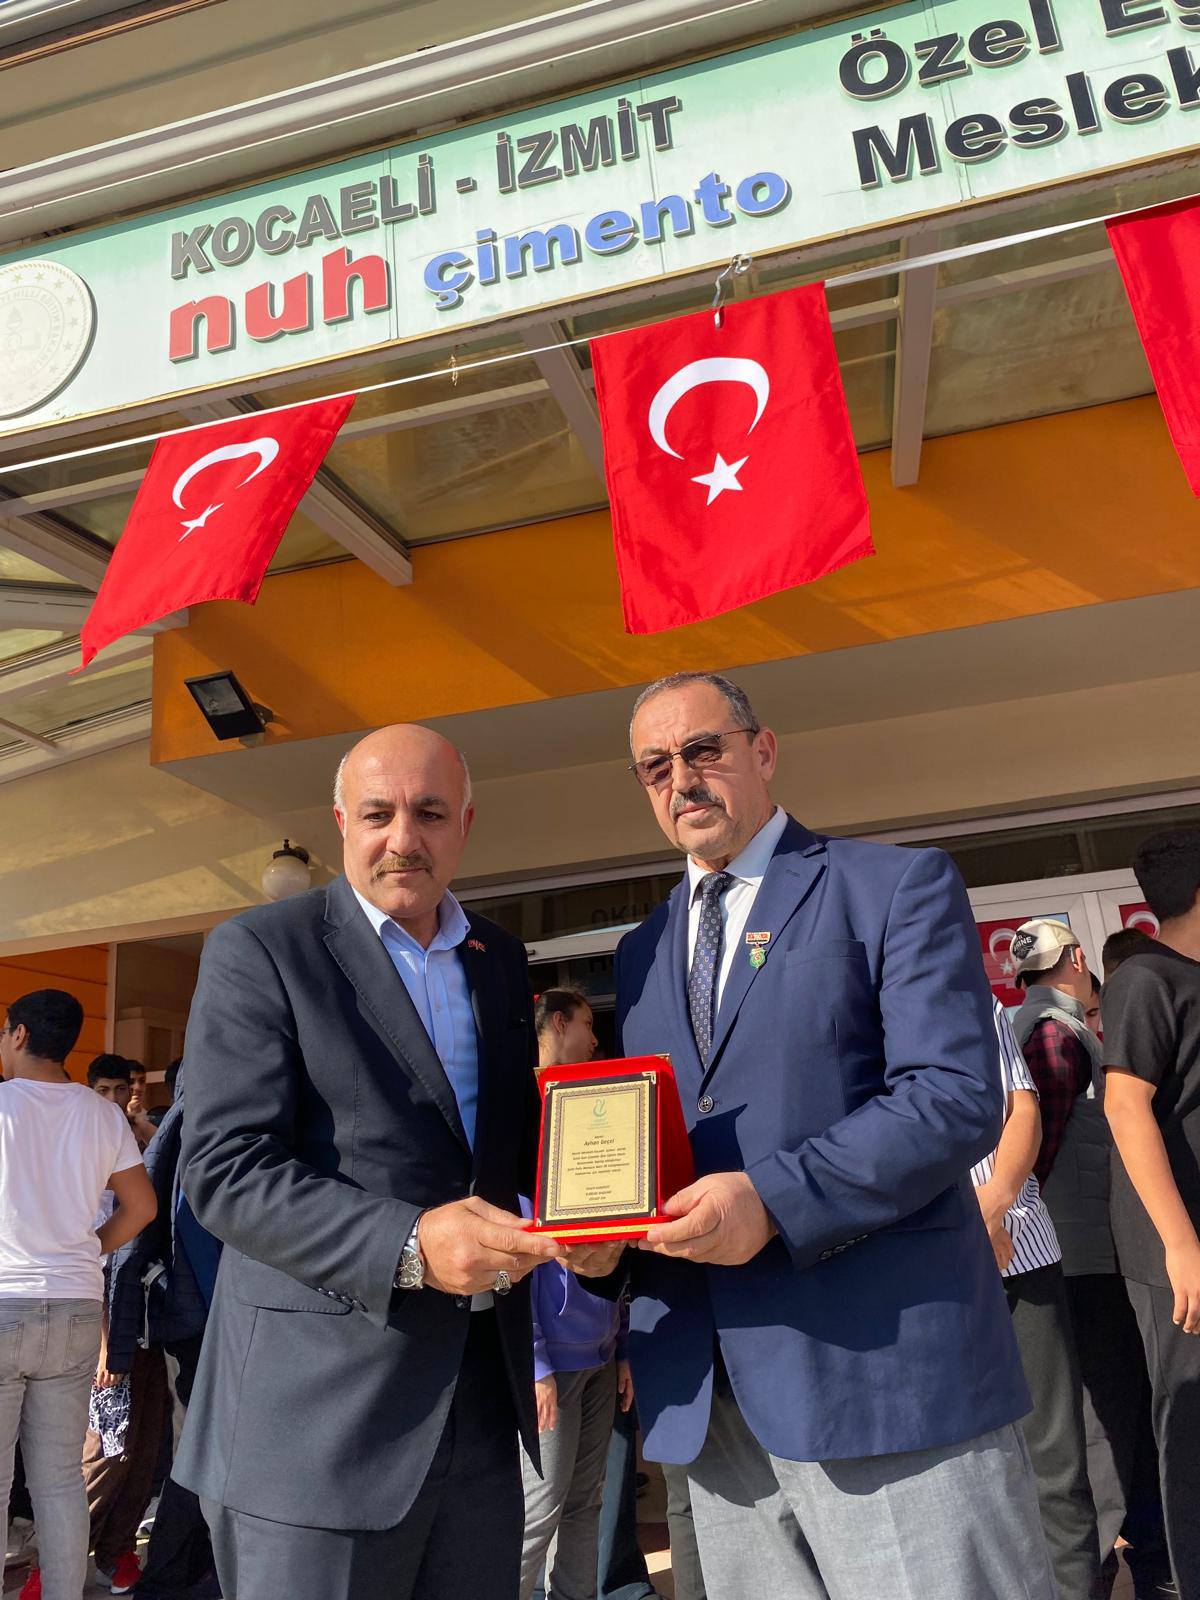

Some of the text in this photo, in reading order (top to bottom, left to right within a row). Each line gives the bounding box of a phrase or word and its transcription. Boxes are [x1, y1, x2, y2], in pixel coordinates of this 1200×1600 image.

[838, 0, 1200, 99] Özel E
[169, 171, 789, 361] nuh çimento
[170, 153, 434, 279] KOCAELİ
[496, 95, 680, 193] İZMİT
